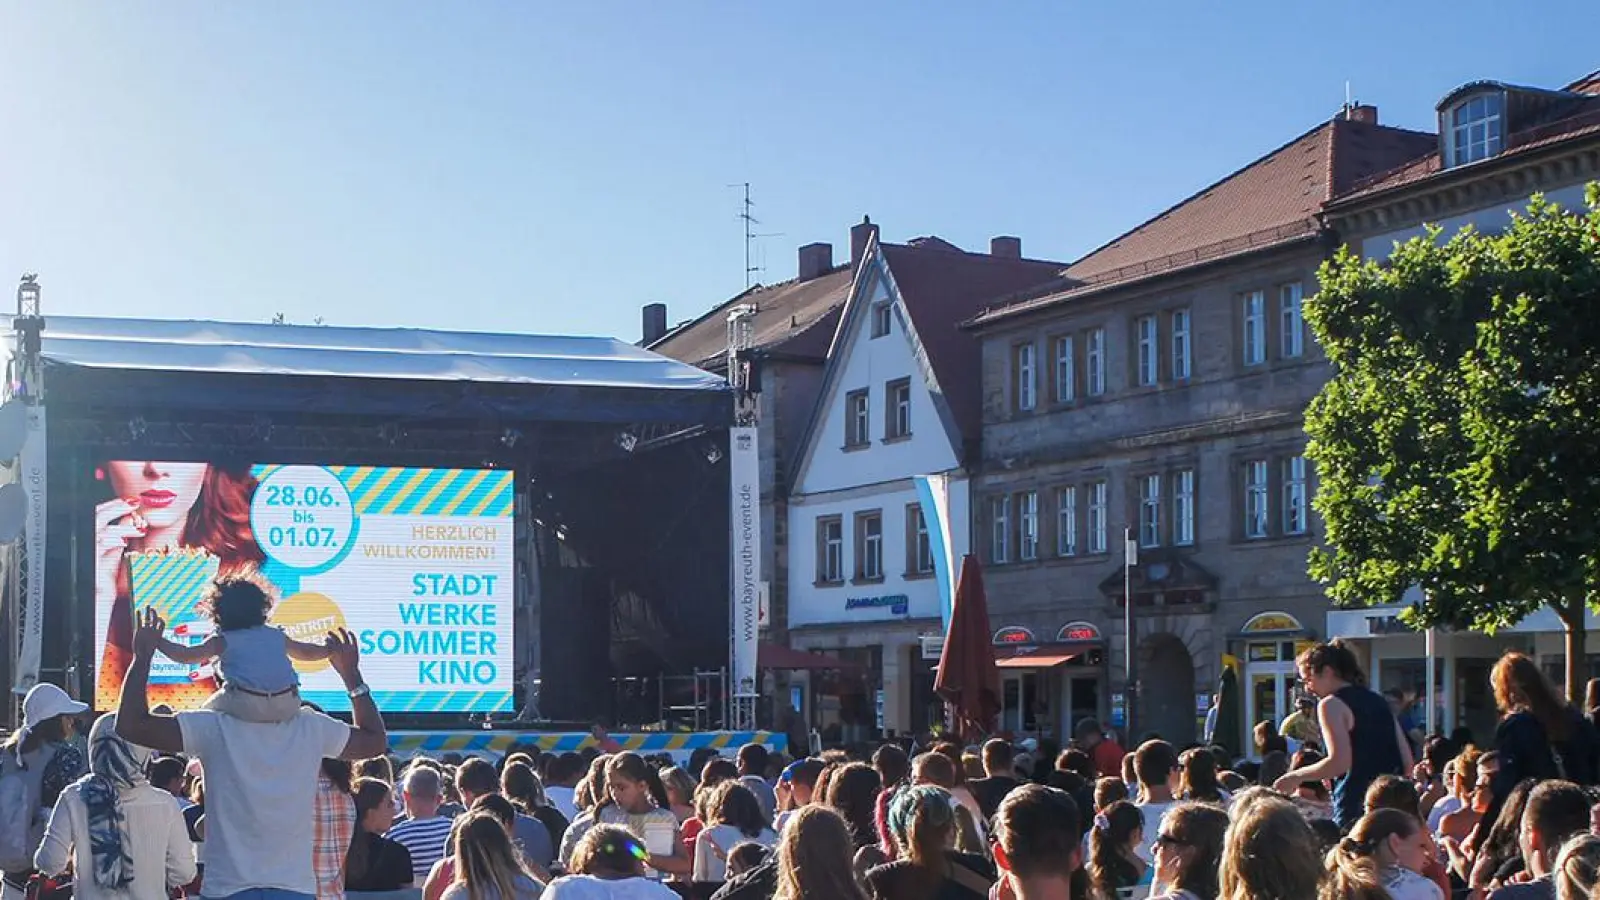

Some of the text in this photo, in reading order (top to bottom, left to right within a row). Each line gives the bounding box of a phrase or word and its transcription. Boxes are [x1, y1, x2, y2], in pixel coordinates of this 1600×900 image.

[266, 485, 341, 507] 28.06.
[293, 510, 315, 523] bis
[269, 527, 338, 547] 01.07.
[412, 525, 496, 541] HERZLICH
[363, 544, 496, 560] WILLKOMMEN!
[740, 484, 755, 641] www.bayreuth-event.de
[412, 573, 498, 595] STADT
[398, 603, 497, 625] WERKE
[359, 629, 497, 655] SOMMER
[418, 660, 497, 685] KINO
